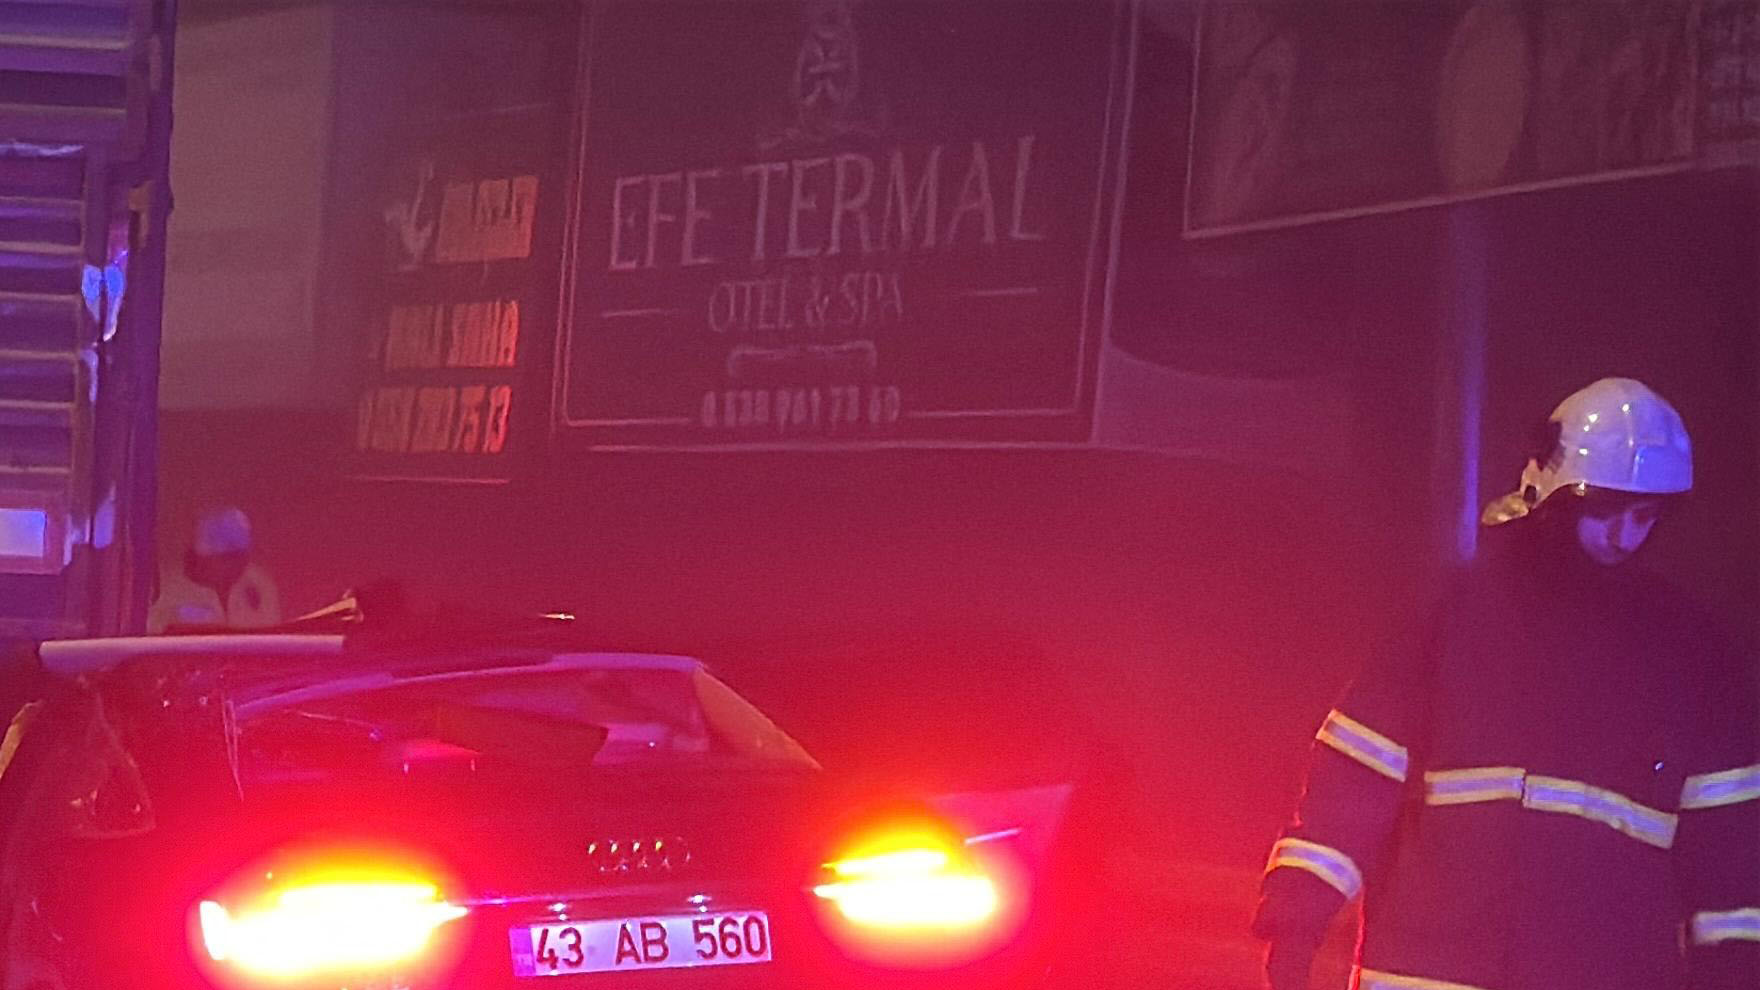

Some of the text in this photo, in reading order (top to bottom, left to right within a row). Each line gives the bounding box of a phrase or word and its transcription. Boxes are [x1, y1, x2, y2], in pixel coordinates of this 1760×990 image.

[610, 167, 721, 271] EFE
[742, 134, 1046, 262] TERMAL
[536, 914, 768, 971] 43 AB 560
